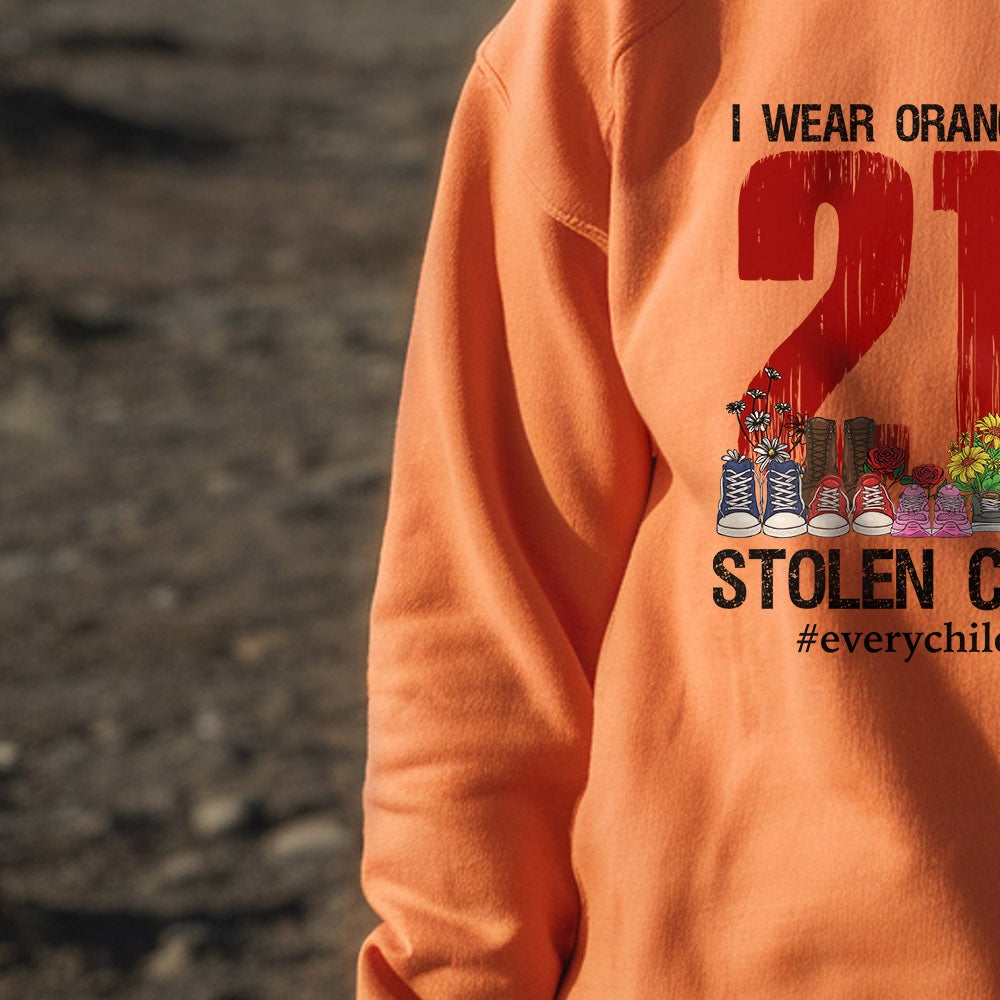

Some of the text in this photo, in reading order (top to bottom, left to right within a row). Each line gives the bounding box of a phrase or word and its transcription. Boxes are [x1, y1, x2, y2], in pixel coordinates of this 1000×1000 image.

[732, 103, 741, 142] I
[761, 103, 875, 142] WEAR
[712, 548, 934, 610] STOLEN
